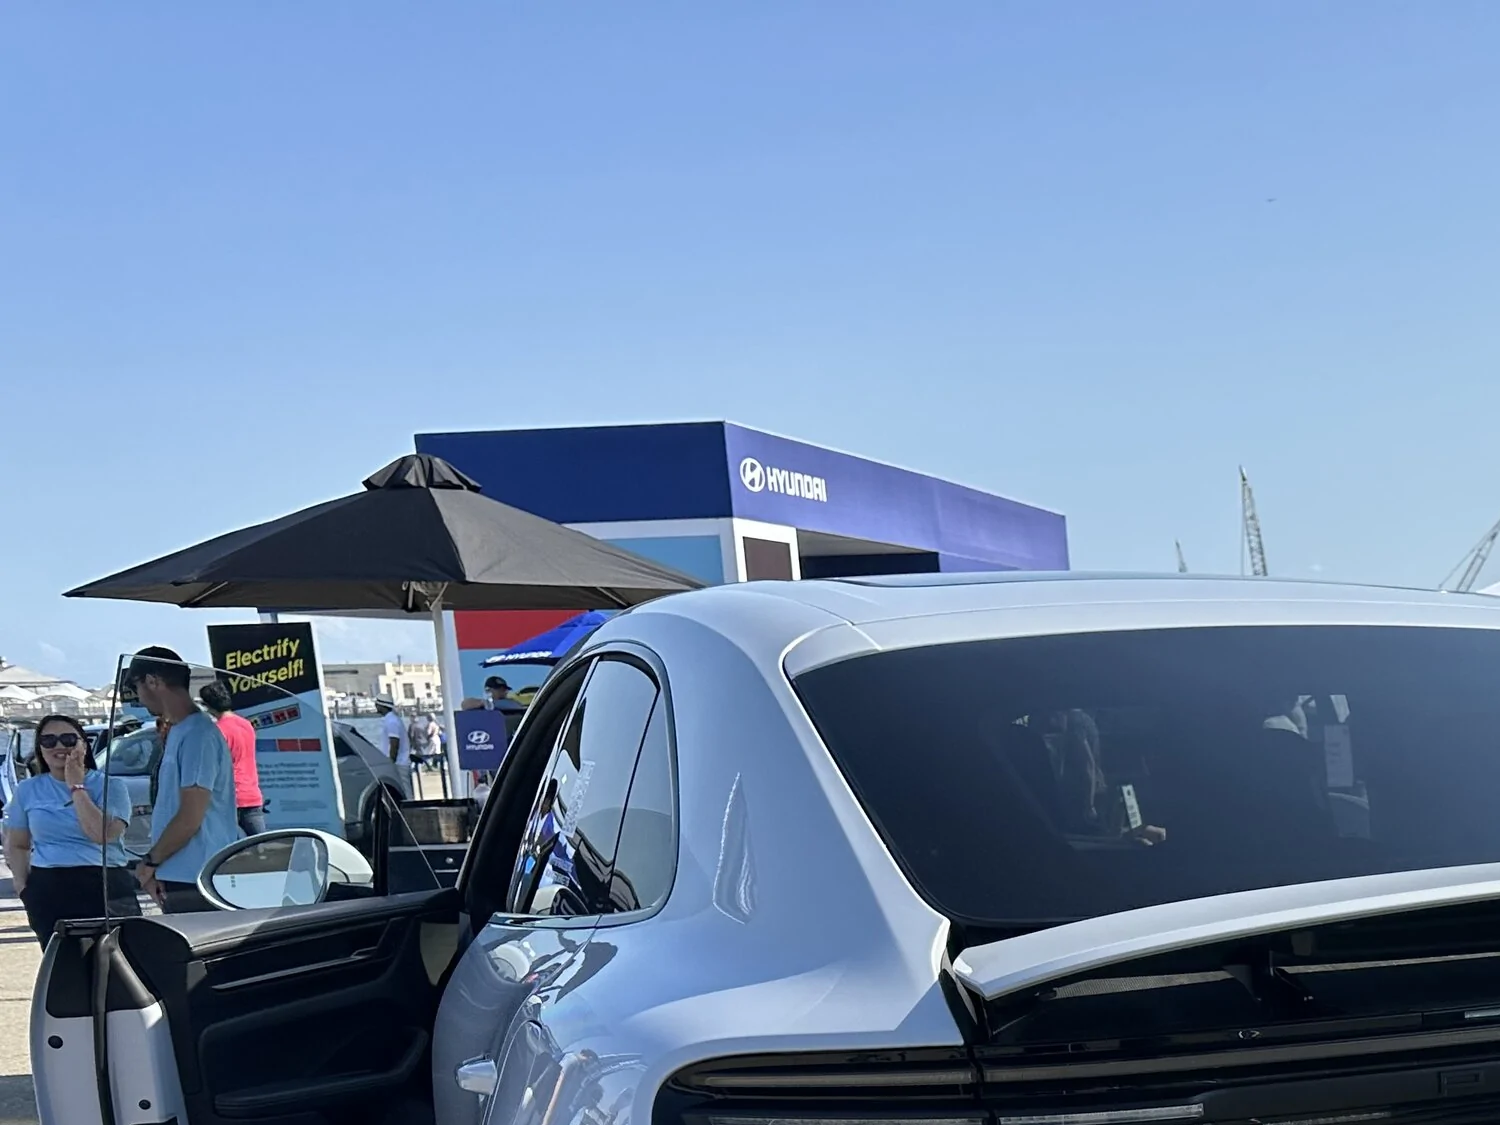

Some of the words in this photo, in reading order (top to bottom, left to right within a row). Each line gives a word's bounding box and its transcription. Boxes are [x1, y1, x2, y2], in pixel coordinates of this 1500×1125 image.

[766, 466, 828, 502] HYUNDAI
[225, 637, 300, 671] Electrify
[228, 658, 305, 694] Yourself!
[465, 743, 494, 751] HYUNDAI
